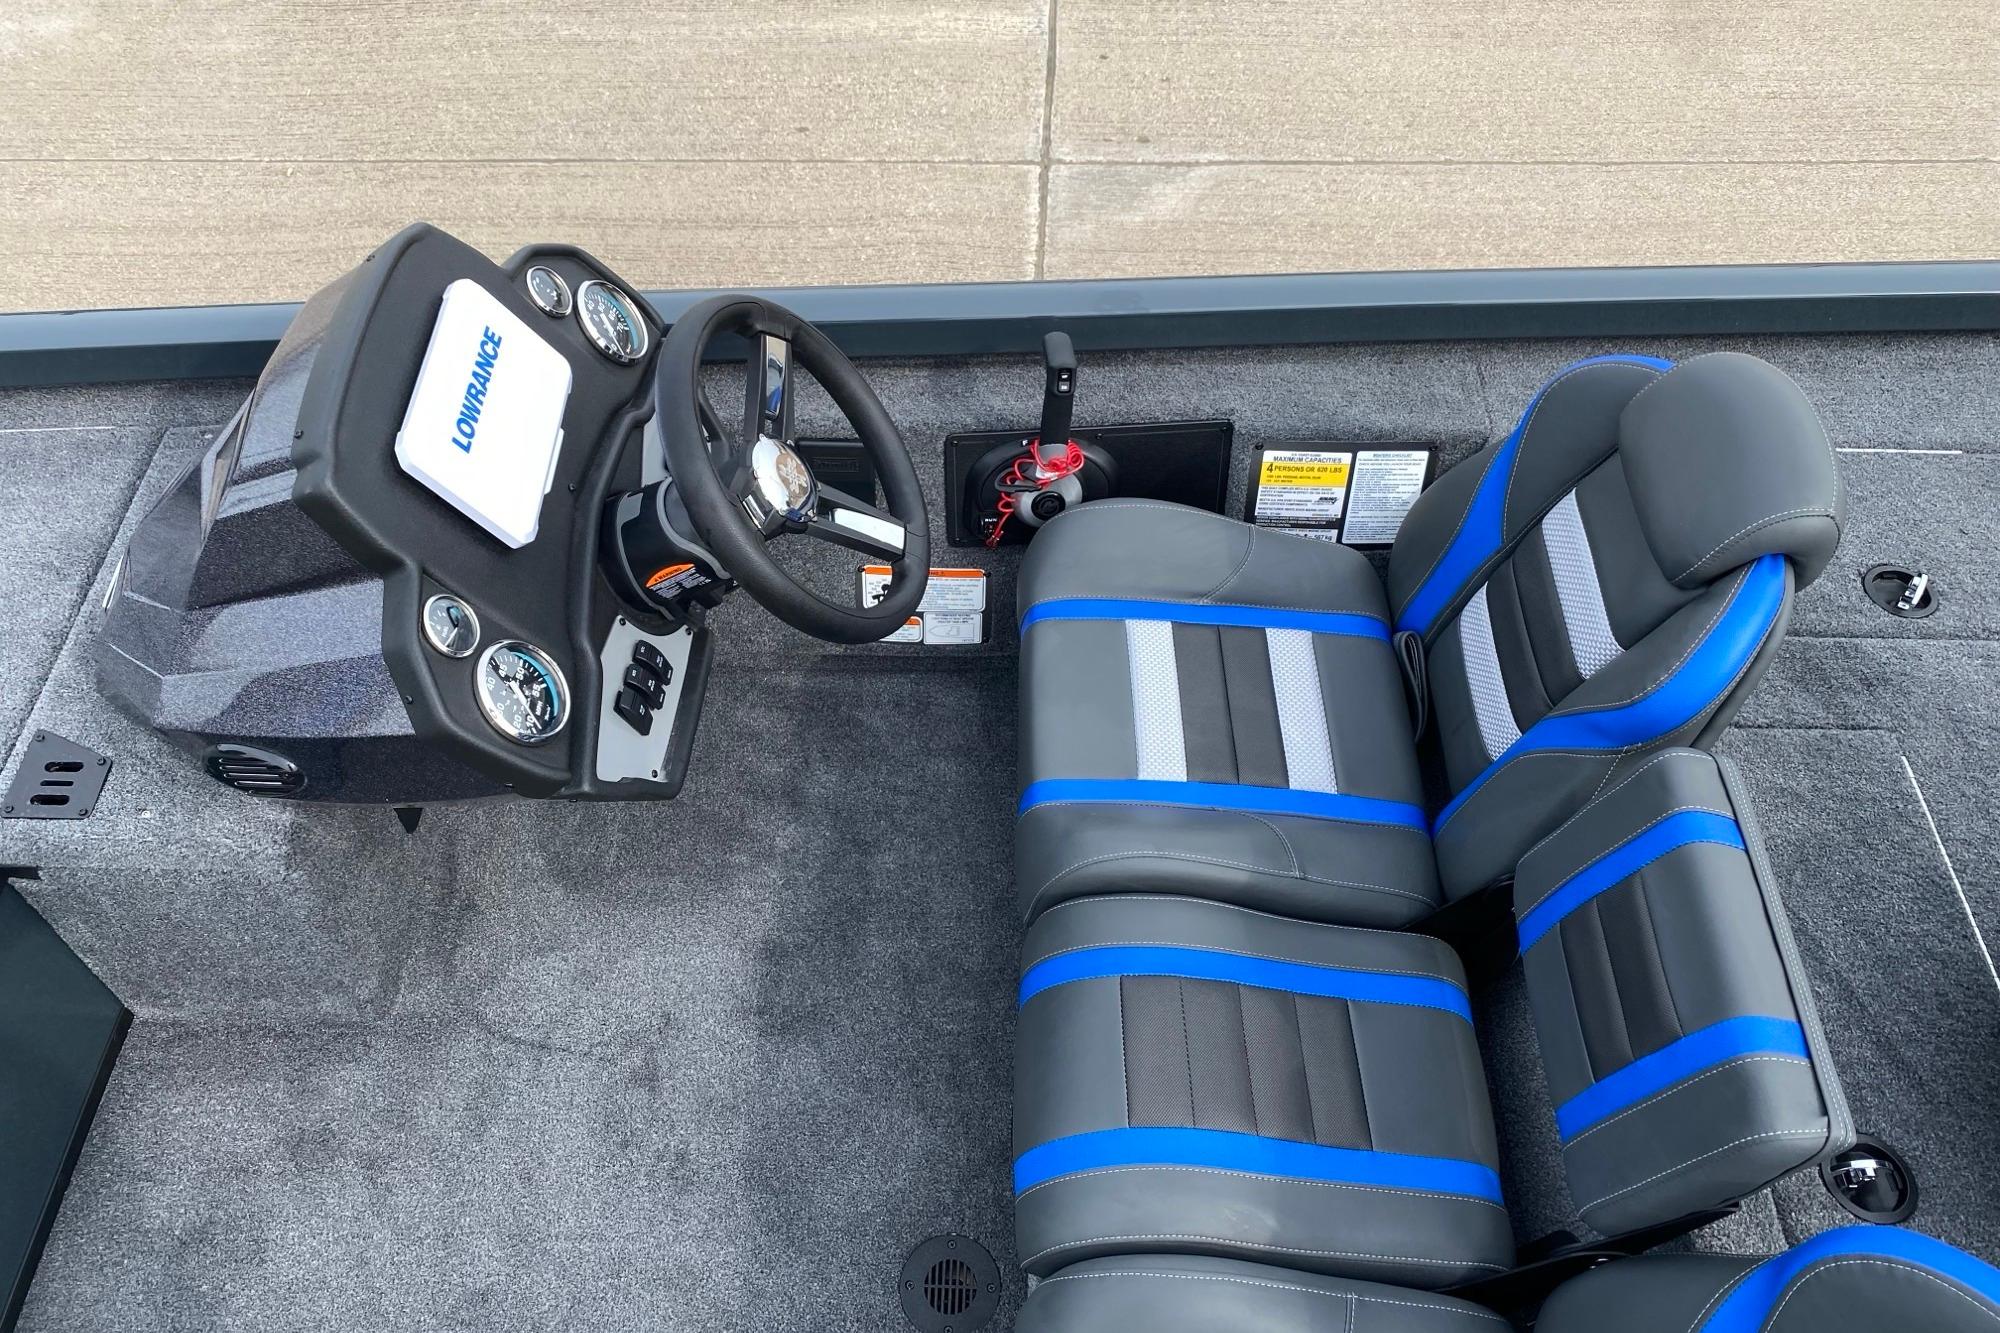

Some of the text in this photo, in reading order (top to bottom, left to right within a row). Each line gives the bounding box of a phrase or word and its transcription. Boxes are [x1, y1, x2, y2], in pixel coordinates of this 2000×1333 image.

[452, 325, 502, 454] LOWRANCE
[1266, 462, 1274, 473] 4
[498, 664, 508, 678] 45
[516, 667, 525, 680] 50
[486, 676, 496, 690] 40
[532, 683, 541, 698] 55
[513, 714, 522, 728] 20
[526, 714, 535, 728] 10
